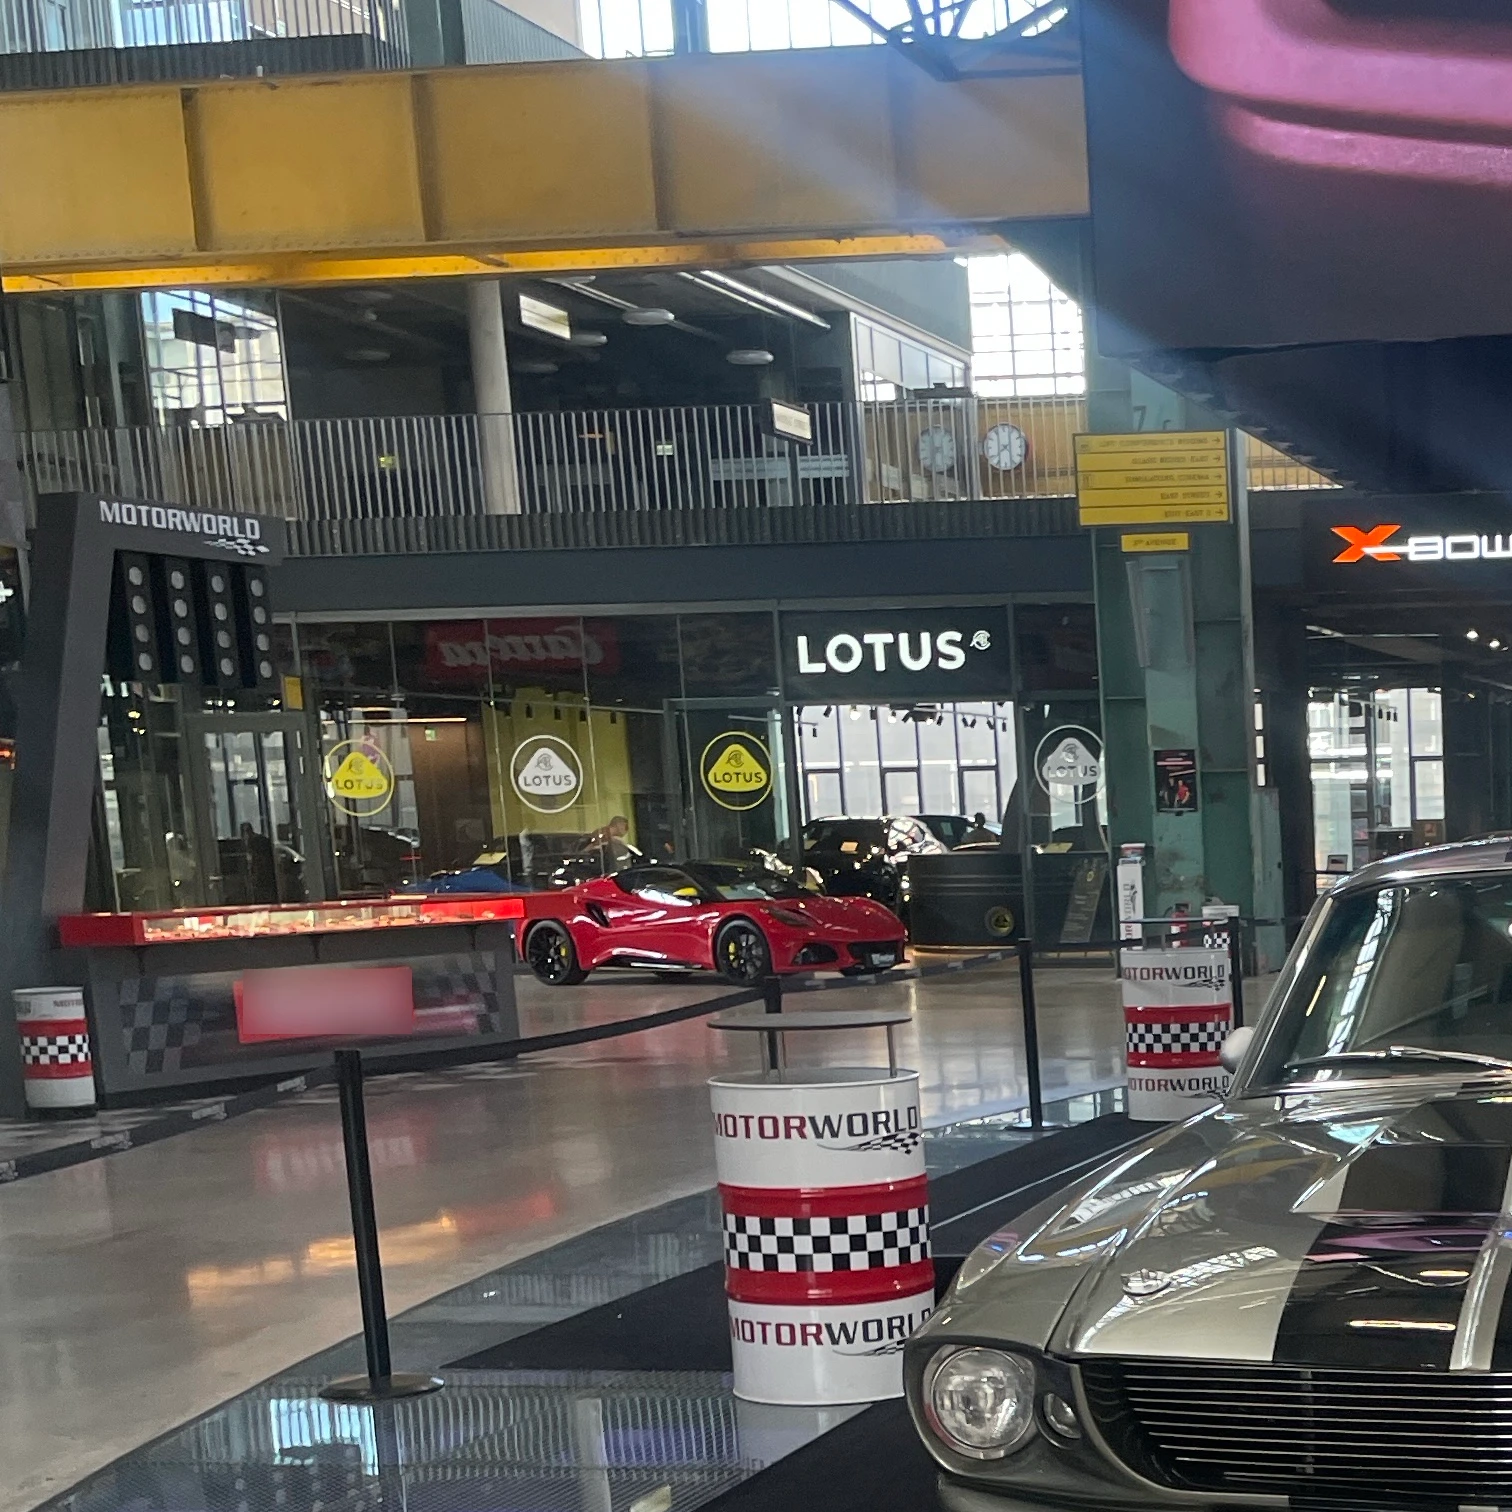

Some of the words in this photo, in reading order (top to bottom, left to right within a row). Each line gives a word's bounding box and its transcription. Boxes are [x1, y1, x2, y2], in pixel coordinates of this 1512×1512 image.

[100, 500, 261, 540] MOTORWORLD
[797, 630, 966, 674] LOTUS
[713, 772, 763, 783] LOTUS
[1048, 765, 1097, 778] LOTUS
[335, 779, 383, 790] LOTUS
[523, 775, 572, 787] LOTUS
[1121, 964, 1225, 981] OTORWORLD
[1128, 1075, 1230, 1092] OTORWORLD
